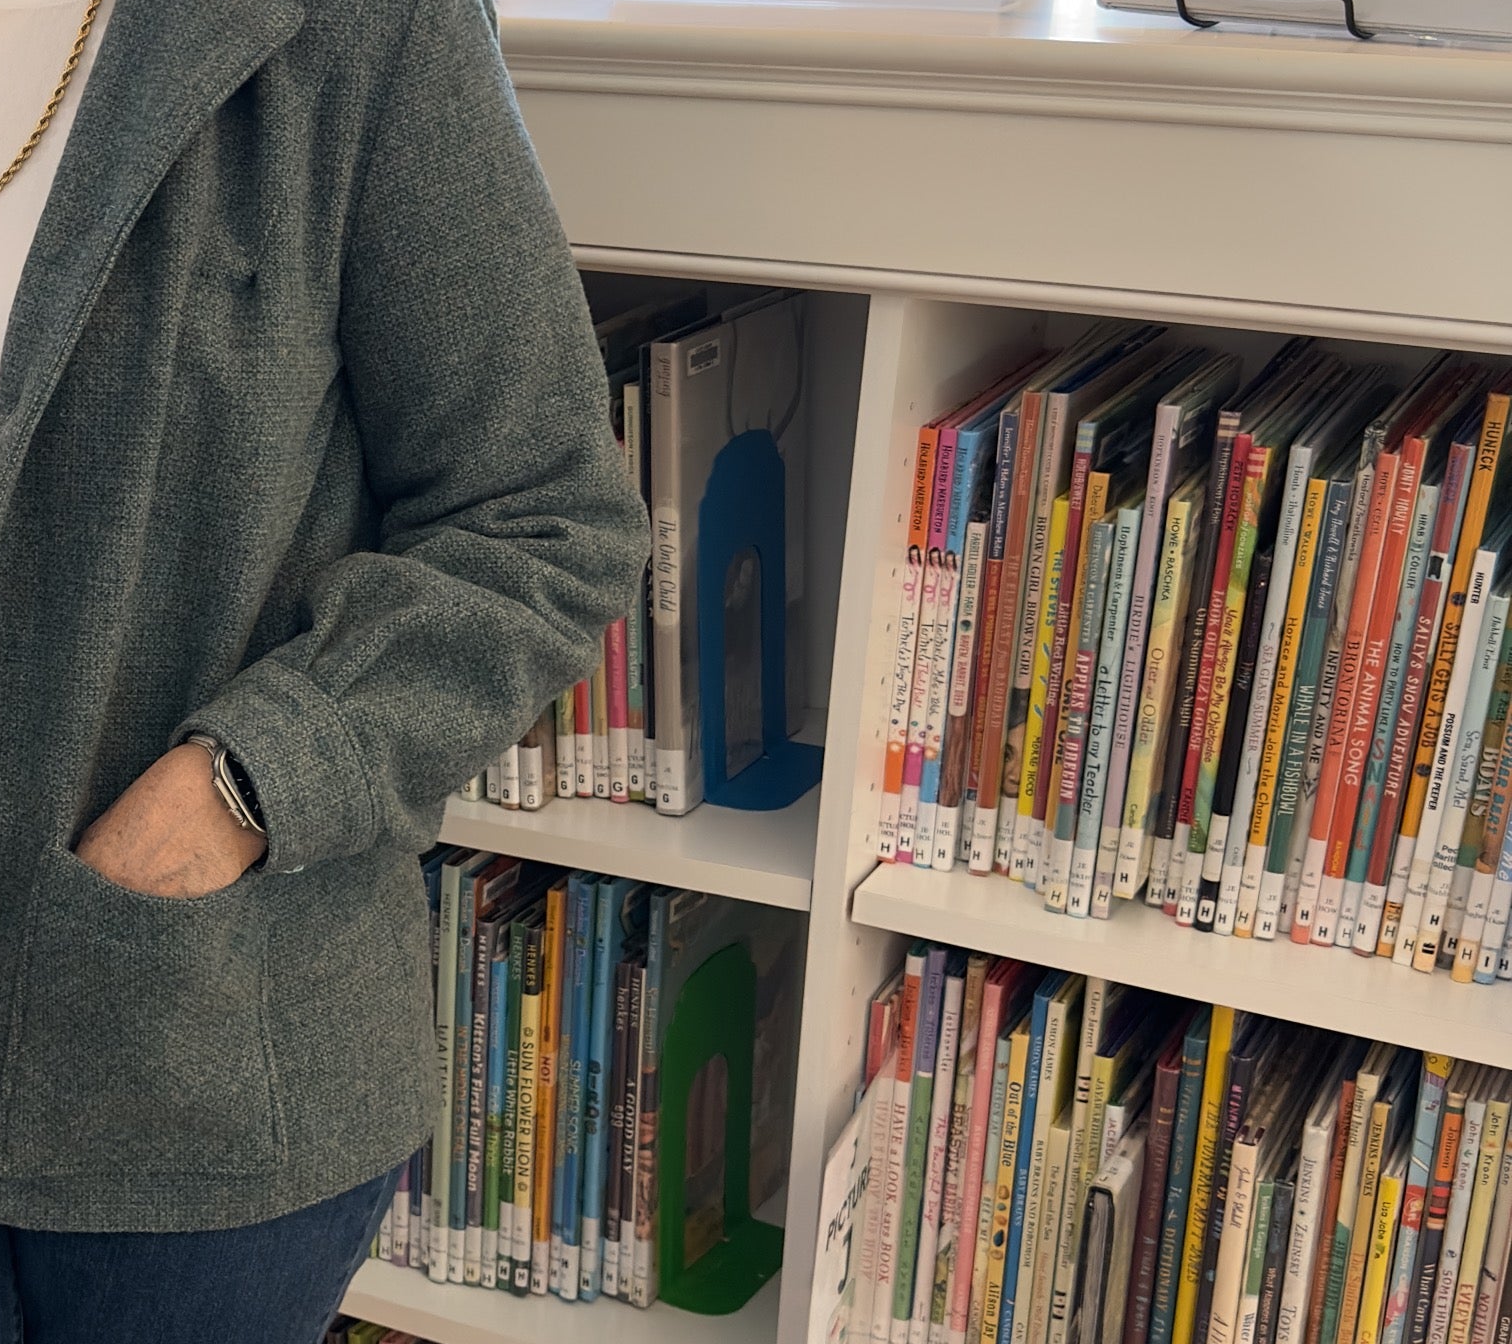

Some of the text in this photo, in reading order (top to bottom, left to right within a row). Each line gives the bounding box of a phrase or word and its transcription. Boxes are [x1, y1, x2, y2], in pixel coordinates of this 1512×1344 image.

[1479, 420, 1501, 471] HUNECK
[1033, 516, 1048, 563] BROWN
[1161, 517, 1181, 601] HOWE RASCHKA
[657, 518, 678, 613] The Only Child
[1471, 572, 1485, 604] HUNTER
[1023, 601, 1037, 646] BROWN
[1018, 647, 1032, 677] GIRL
[1071, 652, 1091, 713] APPLES
[1093, 677, 1111, 719] Letter
[1298, 684, 1316, 726] WHALE
[1308, 649, 1340, 765] INFINITY AND ME
[1344, 639, 1383, 786] THE ANIMAL SONG
[1384, 615, 1431, 799] SALLY'S SNOW ADVENTURE
[1088, 740, 1100, 759] my
[1090, 722, 1106, 737] to
[1252, 616, 1299, 835] Horace and Morris Join the Chorus
[1294, 728, 1307, 748] IN
[1061, 739, 1081, 800] OREGON
[1427, 712, 1457, 811] POSSUM AND THE PEEPER
[1081, 762, 1101, 816] Teacher
[1276, 760, 1301, 816] FISHBOWL
[477, 935, 488, 987] HENKES
[526, 943, 536, 987] HENKES
[468, 1013, 486, 1192] Kitten's First Full Moon
[517, 1041, 534, 1178] SUN FLOWER LION
[611, 1103, 625, 1130] egg
[1009, 1081, 1022, 1105] Out
[1002, 1138, 1017, 1168] Blue
